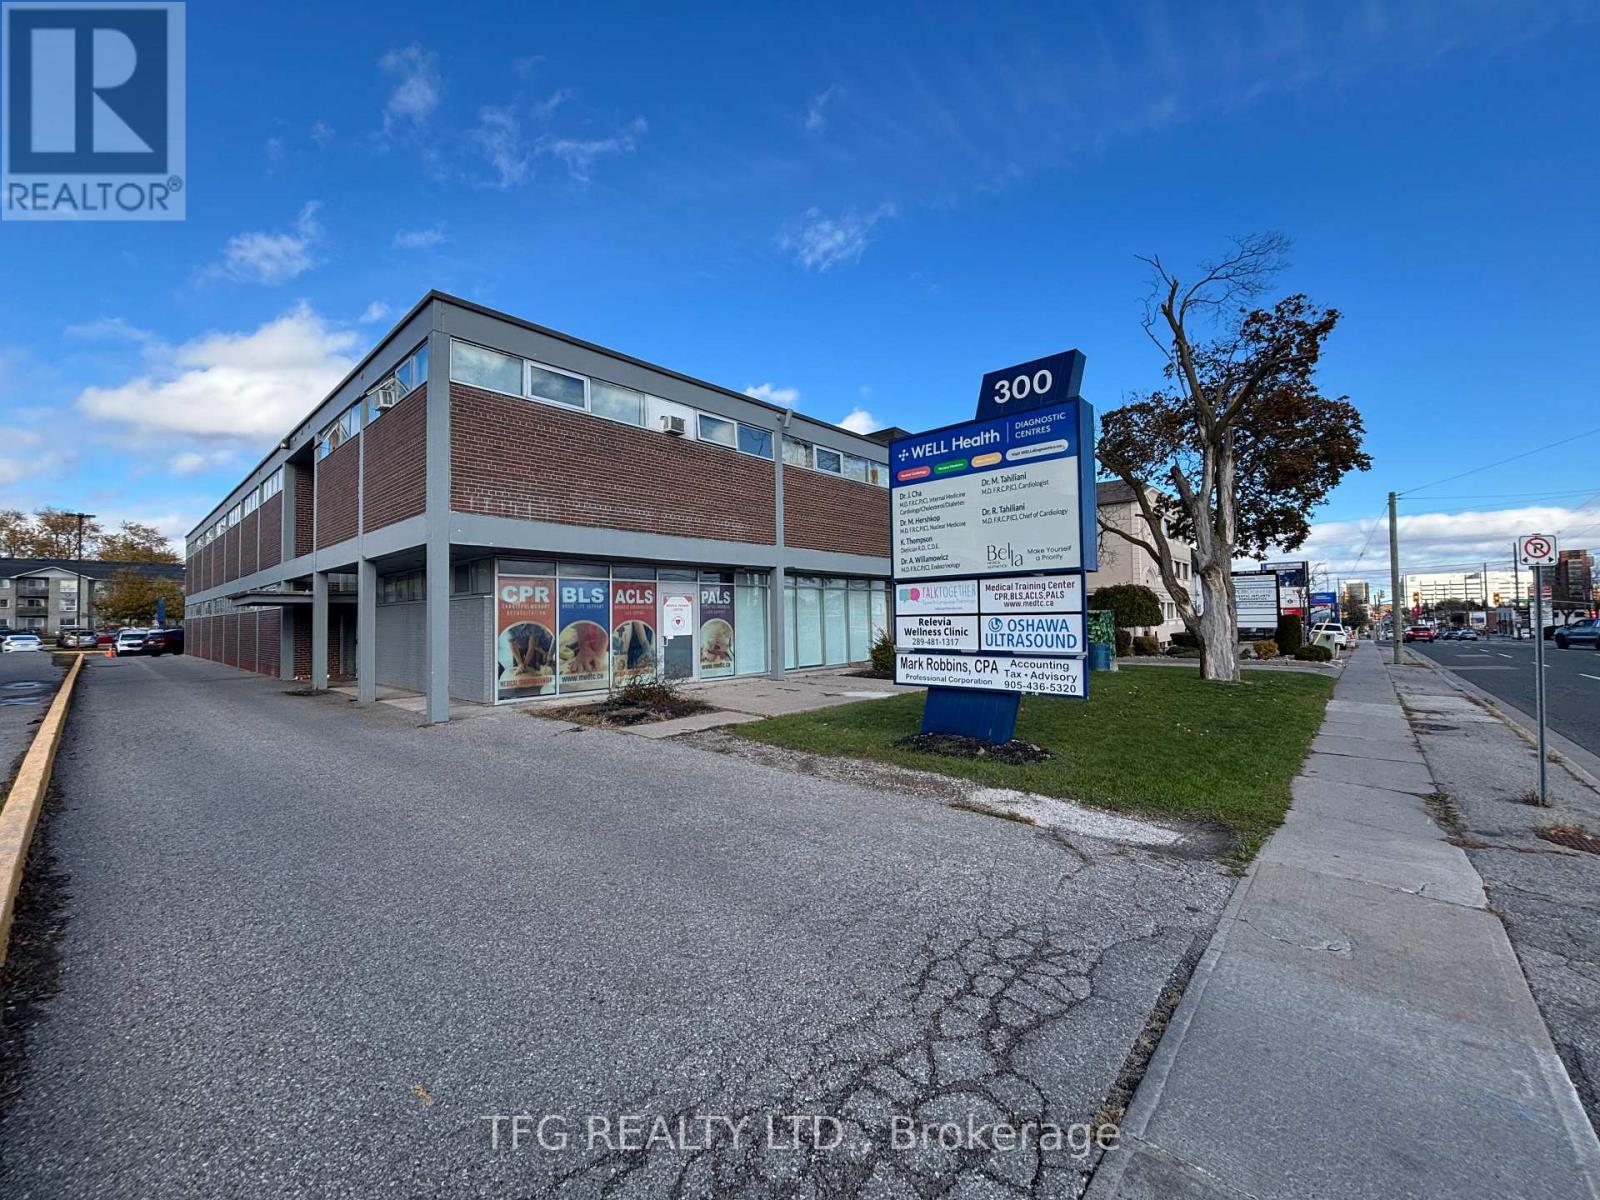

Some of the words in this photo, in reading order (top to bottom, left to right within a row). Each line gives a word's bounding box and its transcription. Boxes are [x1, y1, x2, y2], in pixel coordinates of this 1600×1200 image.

[994, 369, 1053, 404] 300
[1015, 412, 1066, 430] DIAGNOSTIC
[1015, 425, 1051, 439] CENTRES
[911, 440, 949, 459] WELL
[952, 429, 1000, 451] Health
[981, 478, 990, 487] Dr.
[991, 476, 999, 485] M.
[1018, 479, 1049, 490] Cardiologist
[912, 490, 922, 498] Cha
[945, 492, 966, 500] Medicine
[981, 508, 990, 516] Dr.
[991, 507, 998, 515] R.
[1019, 512, 1032, 520] Chief
[1039, 508, 1068, 518] Cardiology
[906, 536, 933, 545] Thompson
[986, 541, 1023, 567] Bella
[1046, 545, 1072, 553] Yourself
[1041, 553, 1063, 561] Priority
[985, 583, 1013, 592] Medical
[1014, 582, 1046, 591] Training
[1047, 580, 1075, 590] Center
[501, 585, 550, 604] CPR
[561, 586, 604, 604] BLS
[615, 589, 654, 604] ACLS
[701, 590, 731, 605] PALS
[1003, 600, 1054, 608] www.medtc.ca
[918, 617, 952, 627] Relevia
[1007, 618, 1070, 632] OSHAWA
[904, 627, 942, 636] Wellness
[943, 627, 969, 636] Clinic
[912, 637, 959, 646] 289-481-1317
[985, 633, 1078, 649] ULTRASOUND
[900, 657, 924, 670] Mark
[926, 657, 972, 675] Robbins,
[974, 659, 999, 674] CPA
[1010, 659, 1070, 672] Accounting
[905, 673, 947, 683] Professional
[948, 675, 993, 686] Corporation
[1004, 669, 1022, 679] Tax
[1030, 671, 1078, 684] Advisory
[1004, 680, 1077, 694] 905-436-5320
